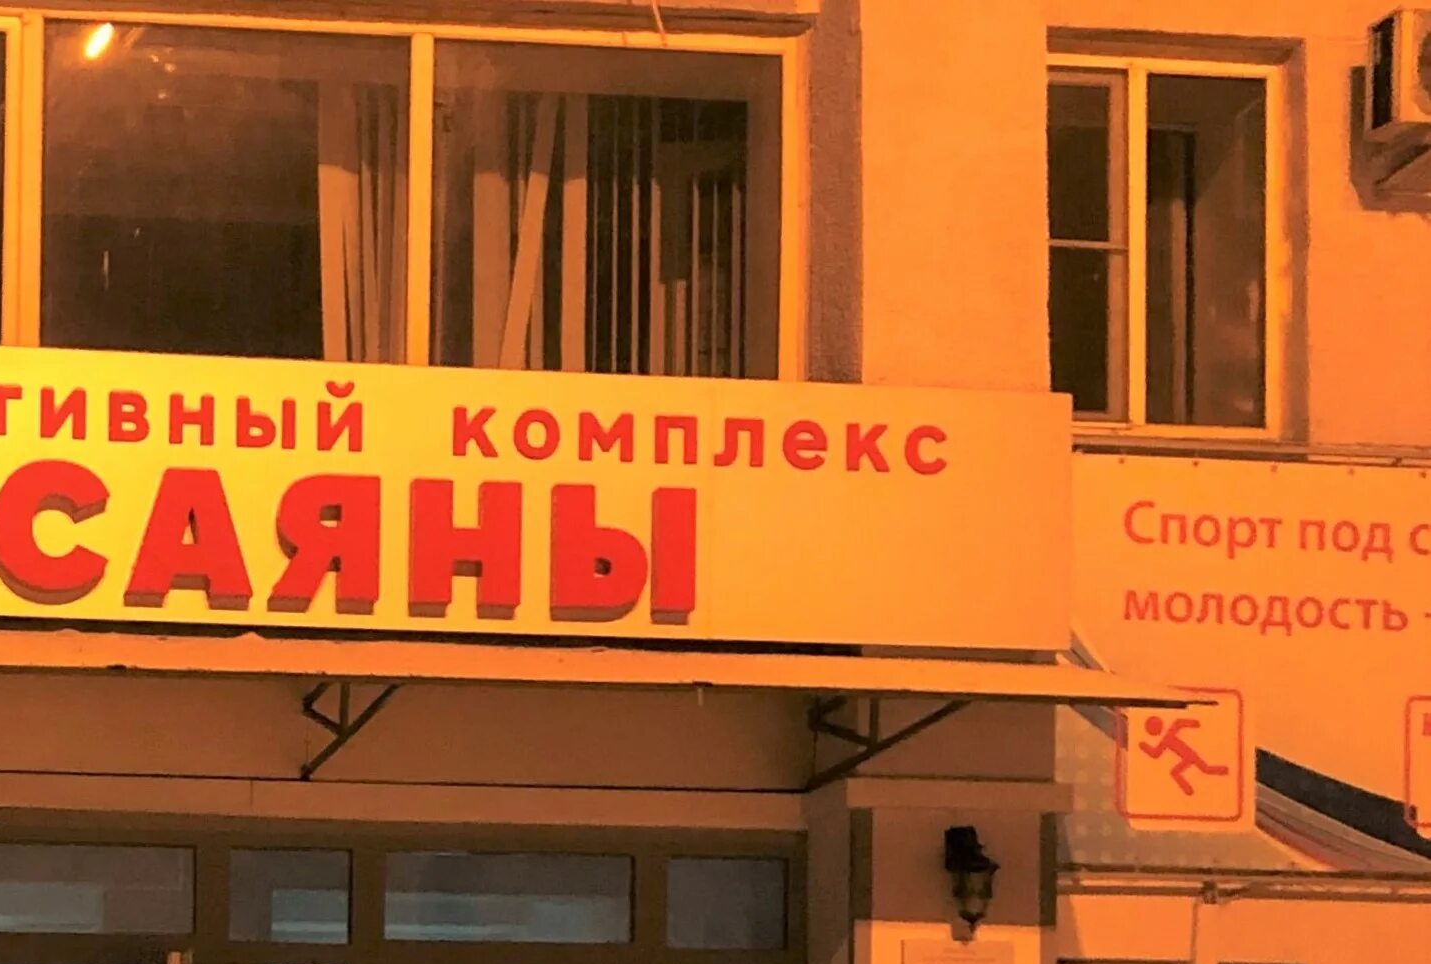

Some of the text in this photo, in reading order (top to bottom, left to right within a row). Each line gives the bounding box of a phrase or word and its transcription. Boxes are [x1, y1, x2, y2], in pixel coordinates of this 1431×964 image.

[452, 406, 949, 476] комплекс
[1123, 500, 1283, 560] Спорт
[1299, 519, 1395, 564] под
[1123, 590, 1409, 637] молодость
